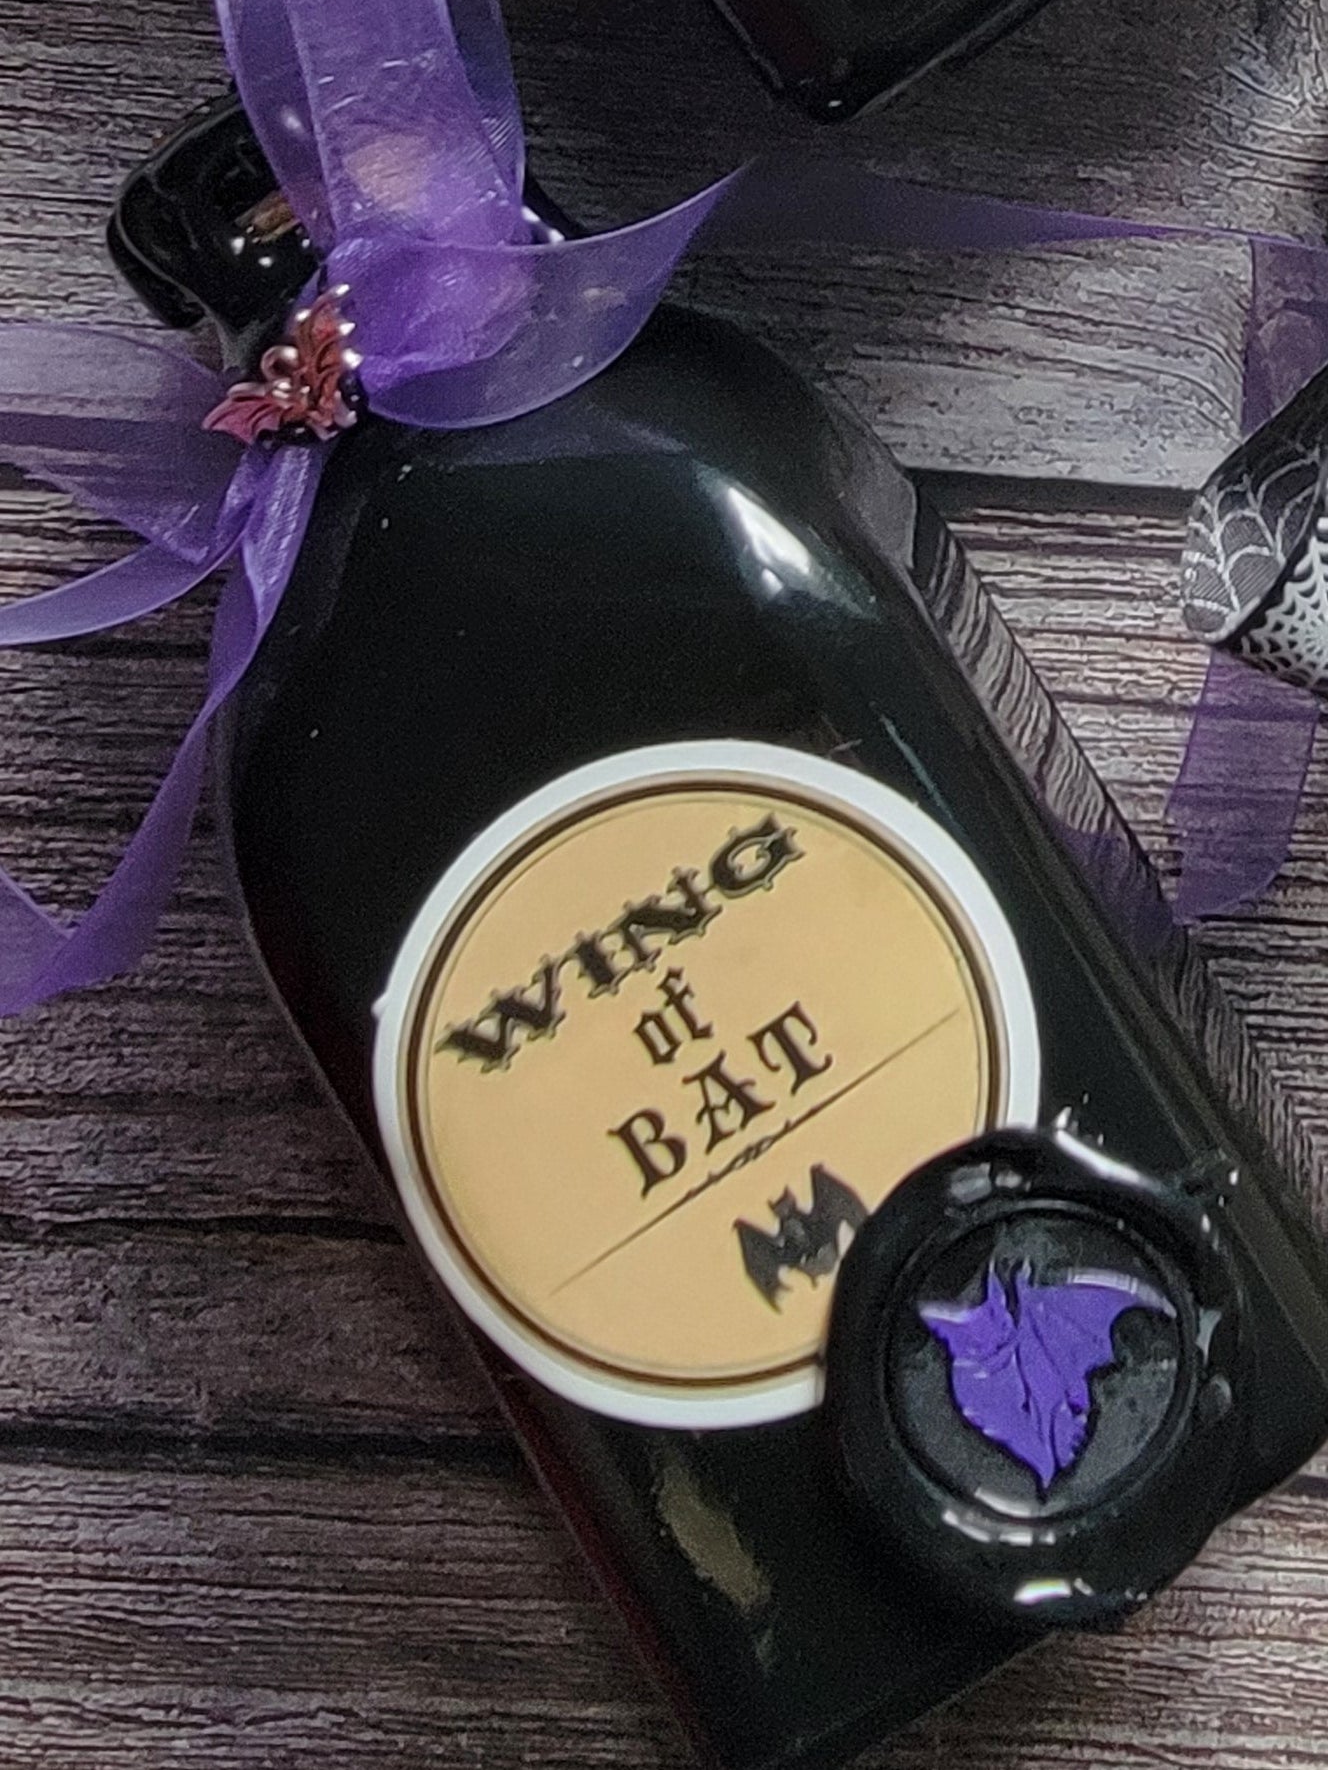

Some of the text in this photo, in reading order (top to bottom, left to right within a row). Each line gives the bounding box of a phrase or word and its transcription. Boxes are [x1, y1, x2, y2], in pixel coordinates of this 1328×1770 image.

[436, 813, 807, 1073] WING
[633, 967, 716, 1066] of
[607, 1001, 833, 1199] BAT
